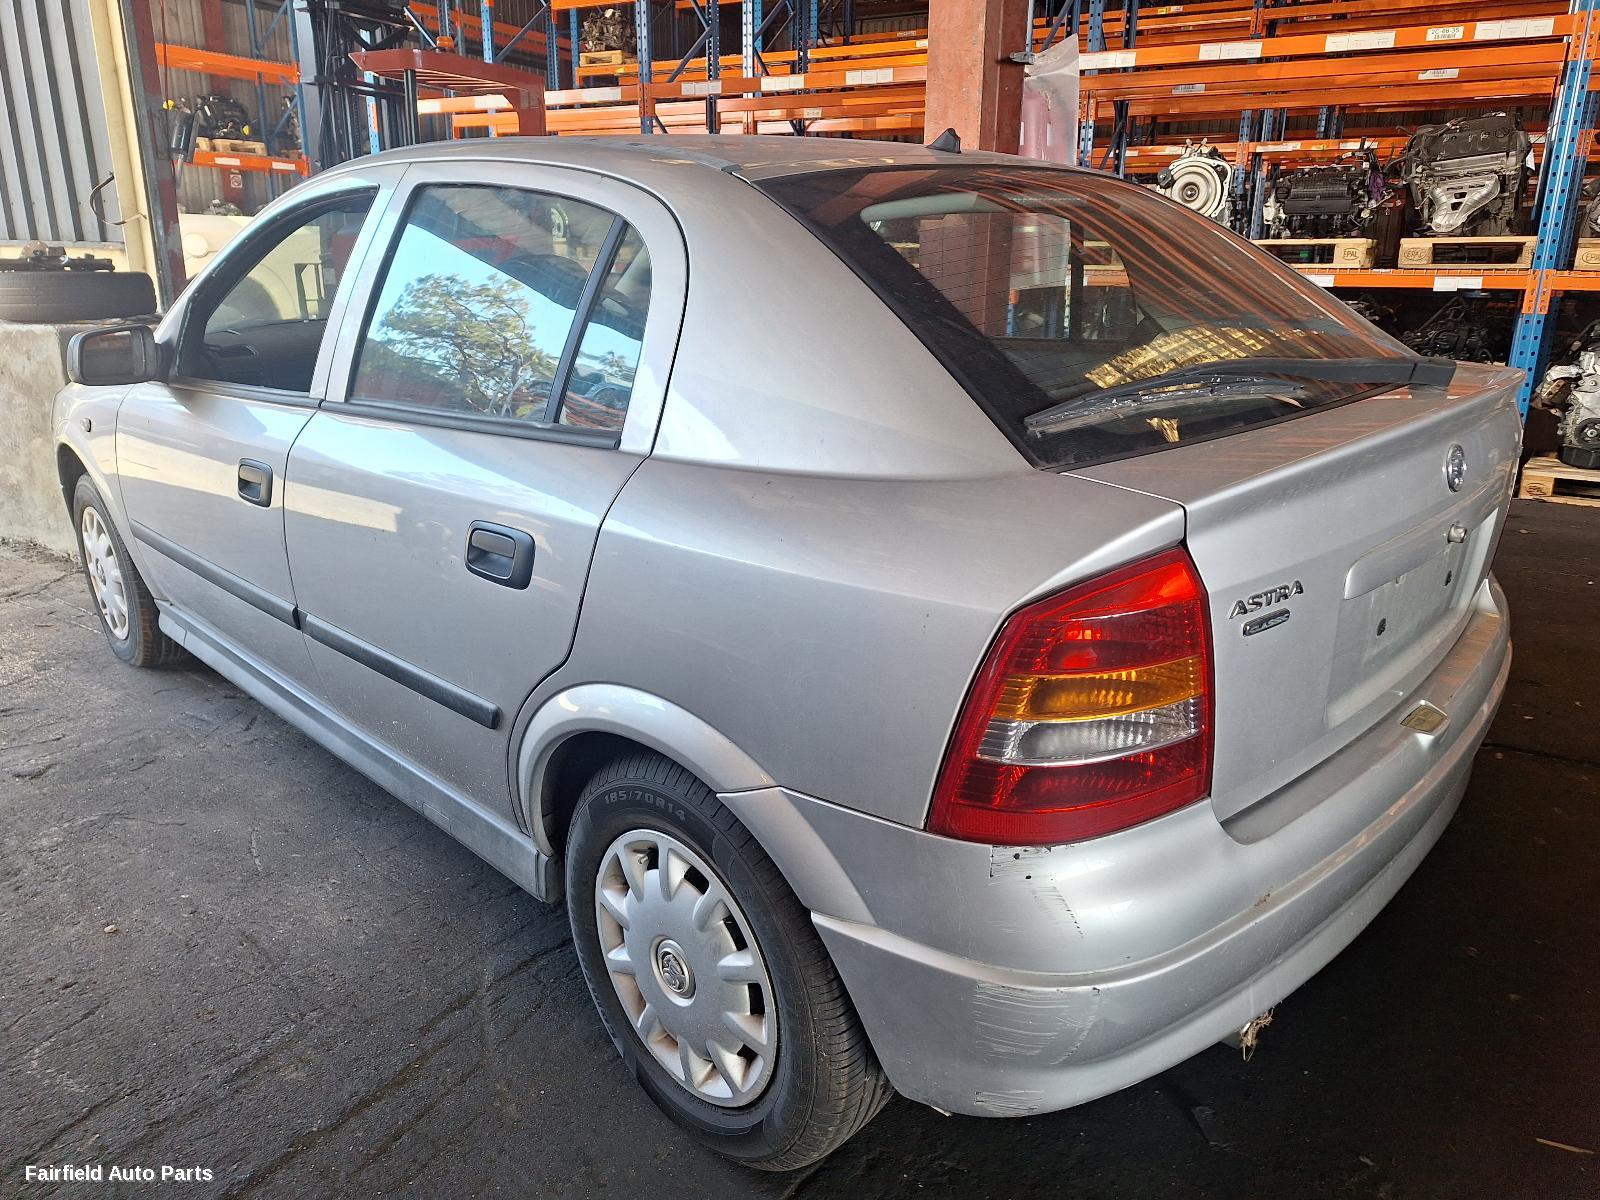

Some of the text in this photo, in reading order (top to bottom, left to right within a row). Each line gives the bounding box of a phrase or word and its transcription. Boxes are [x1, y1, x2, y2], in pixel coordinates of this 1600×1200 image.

[1343, 250, 1357, 258] EPAL
[1228, 580, 1304, 620] ASTRA
[604, 790, 686, 821] 185/70R14
